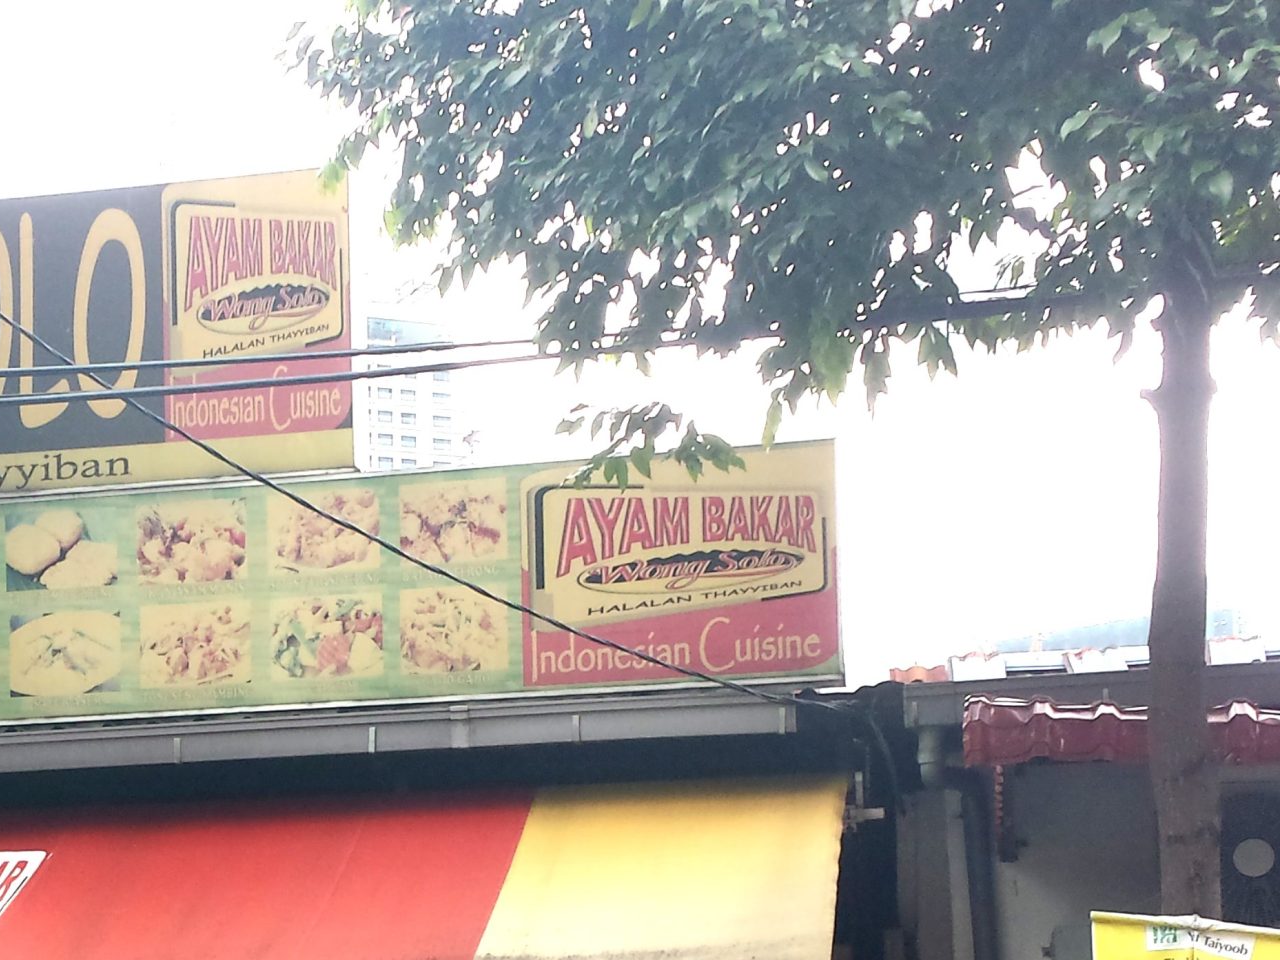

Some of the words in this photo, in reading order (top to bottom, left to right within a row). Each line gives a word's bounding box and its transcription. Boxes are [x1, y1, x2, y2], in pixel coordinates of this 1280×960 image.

[185, 216, 263, 312] AYAM
[270, 219, 337, 291] BAKAR
[210, 293, 275, 330] Wong
[277, 284, 321, 310] Solo
[203, 337, 264, 359] HALALAN
[270, 324, 329, 343] THAYYIBAN
[170, 372, 264, 438] Indonesian
[270, 365, 342, 430] Cuisine
[556, 497, 689, 578] AYAM
[702, 495, 816, 552] BAKAR
[601, 559, 709, 588] Wong
[715, 549, 788, 572] Solo
[588, 595, 692, 615] HALALAN
[701, 580, 802, 599] THAYYIBAN
[531, 630, 690, 682] Indonesian
[699, 617, 820, 672] Cuisine
[1204, 936, 1248, 955] Taiyoob
